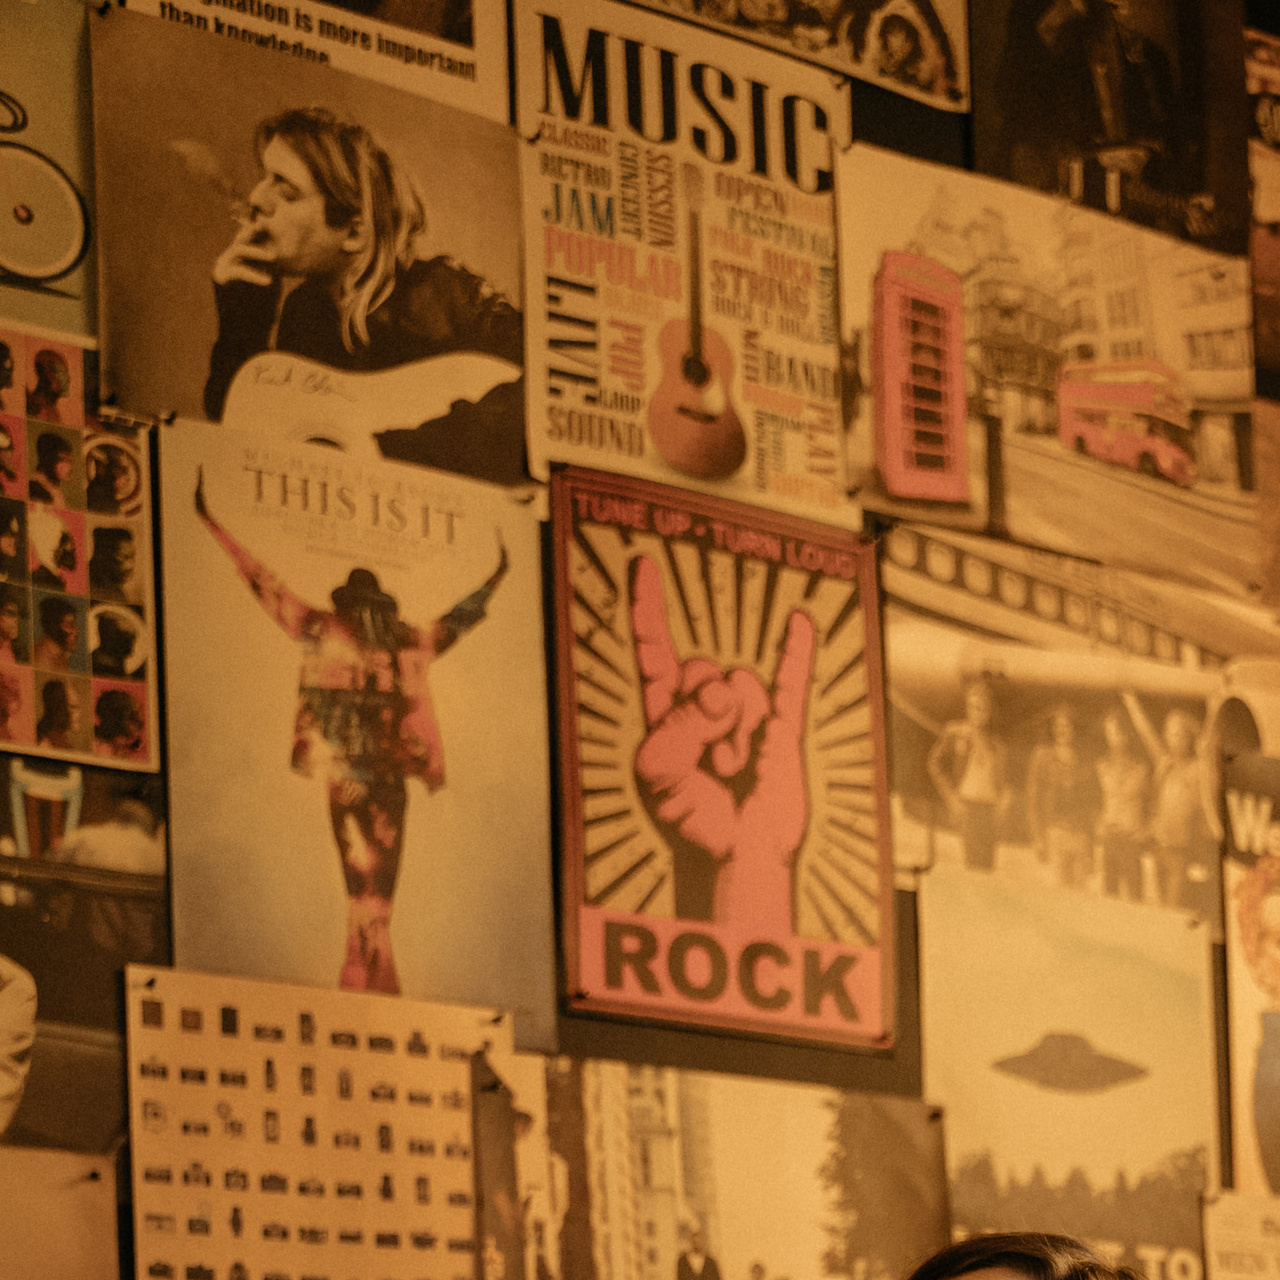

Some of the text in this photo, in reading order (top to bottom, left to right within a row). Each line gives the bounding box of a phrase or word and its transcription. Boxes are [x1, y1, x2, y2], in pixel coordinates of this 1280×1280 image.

[159, 1, 209, 31] than
[295, 9, 313, 34] is
[318, 19, 372, 52] more
[536, 12, 835, 196] MUSIC
[542, 183, 614, 238] JAM
[543, 225, 683, 303] POPULAR
[546, 274, 599, 404] LIVE
[608, 317, 646, 392] POP
[546, 405, 645, 458] SOUND
[243, 465, 357, 522] THIS
[370, 493, 409, 534] IS
[420, 504, 466, 546] IT
[604, 921, 860, 1022] ROCK
